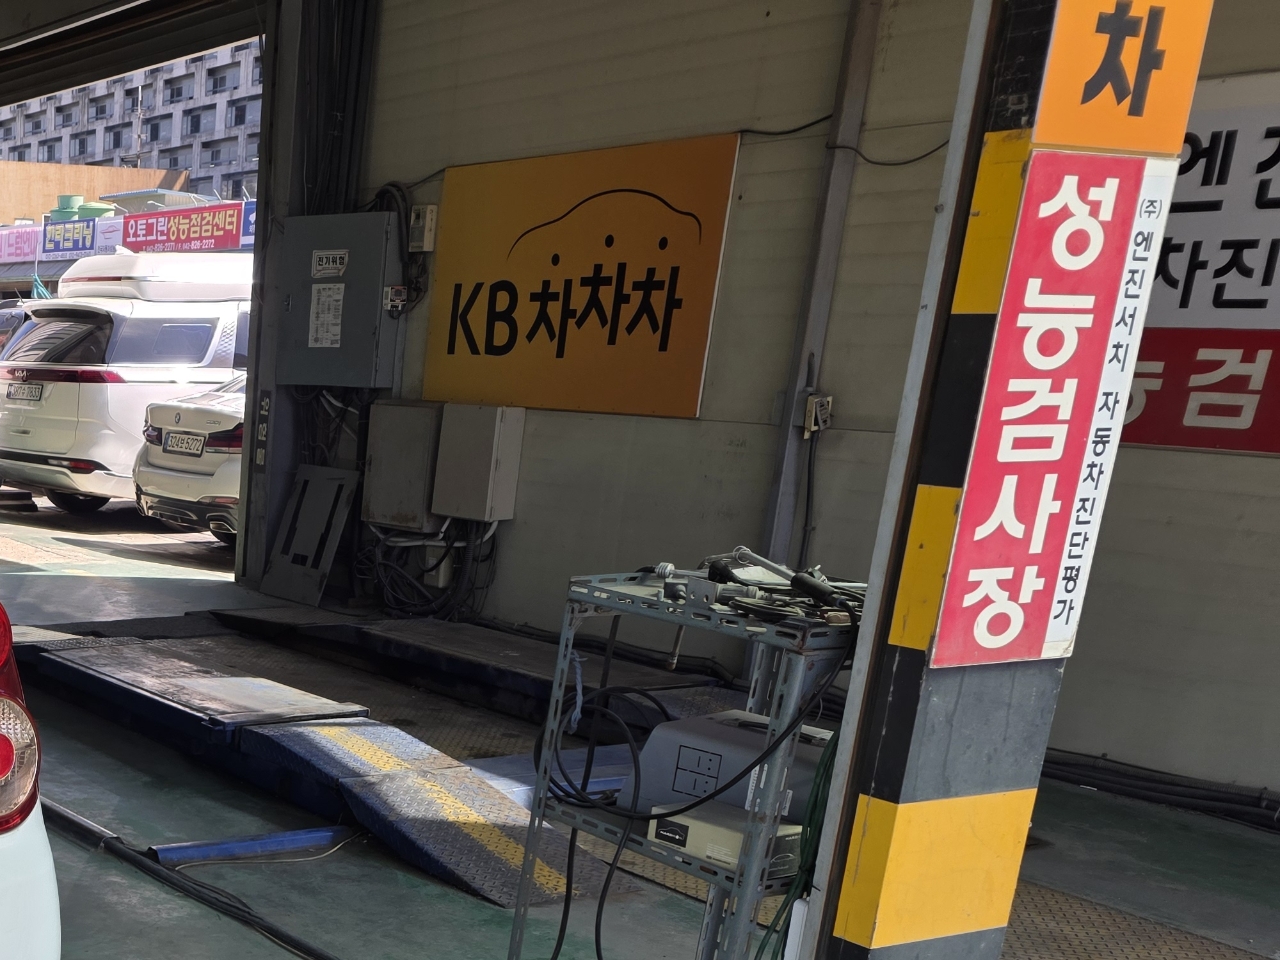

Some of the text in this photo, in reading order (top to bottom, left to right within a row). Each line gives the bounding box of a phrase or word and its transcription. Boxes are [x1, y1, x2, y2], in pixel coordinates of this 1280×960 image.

[1080, 0, 1166, 118] 차
[1172, 126, 1280, 213] 엔
[318, 256, 344, 266] 전기위험
[962, 175, 1120, 649] 성능검사장
